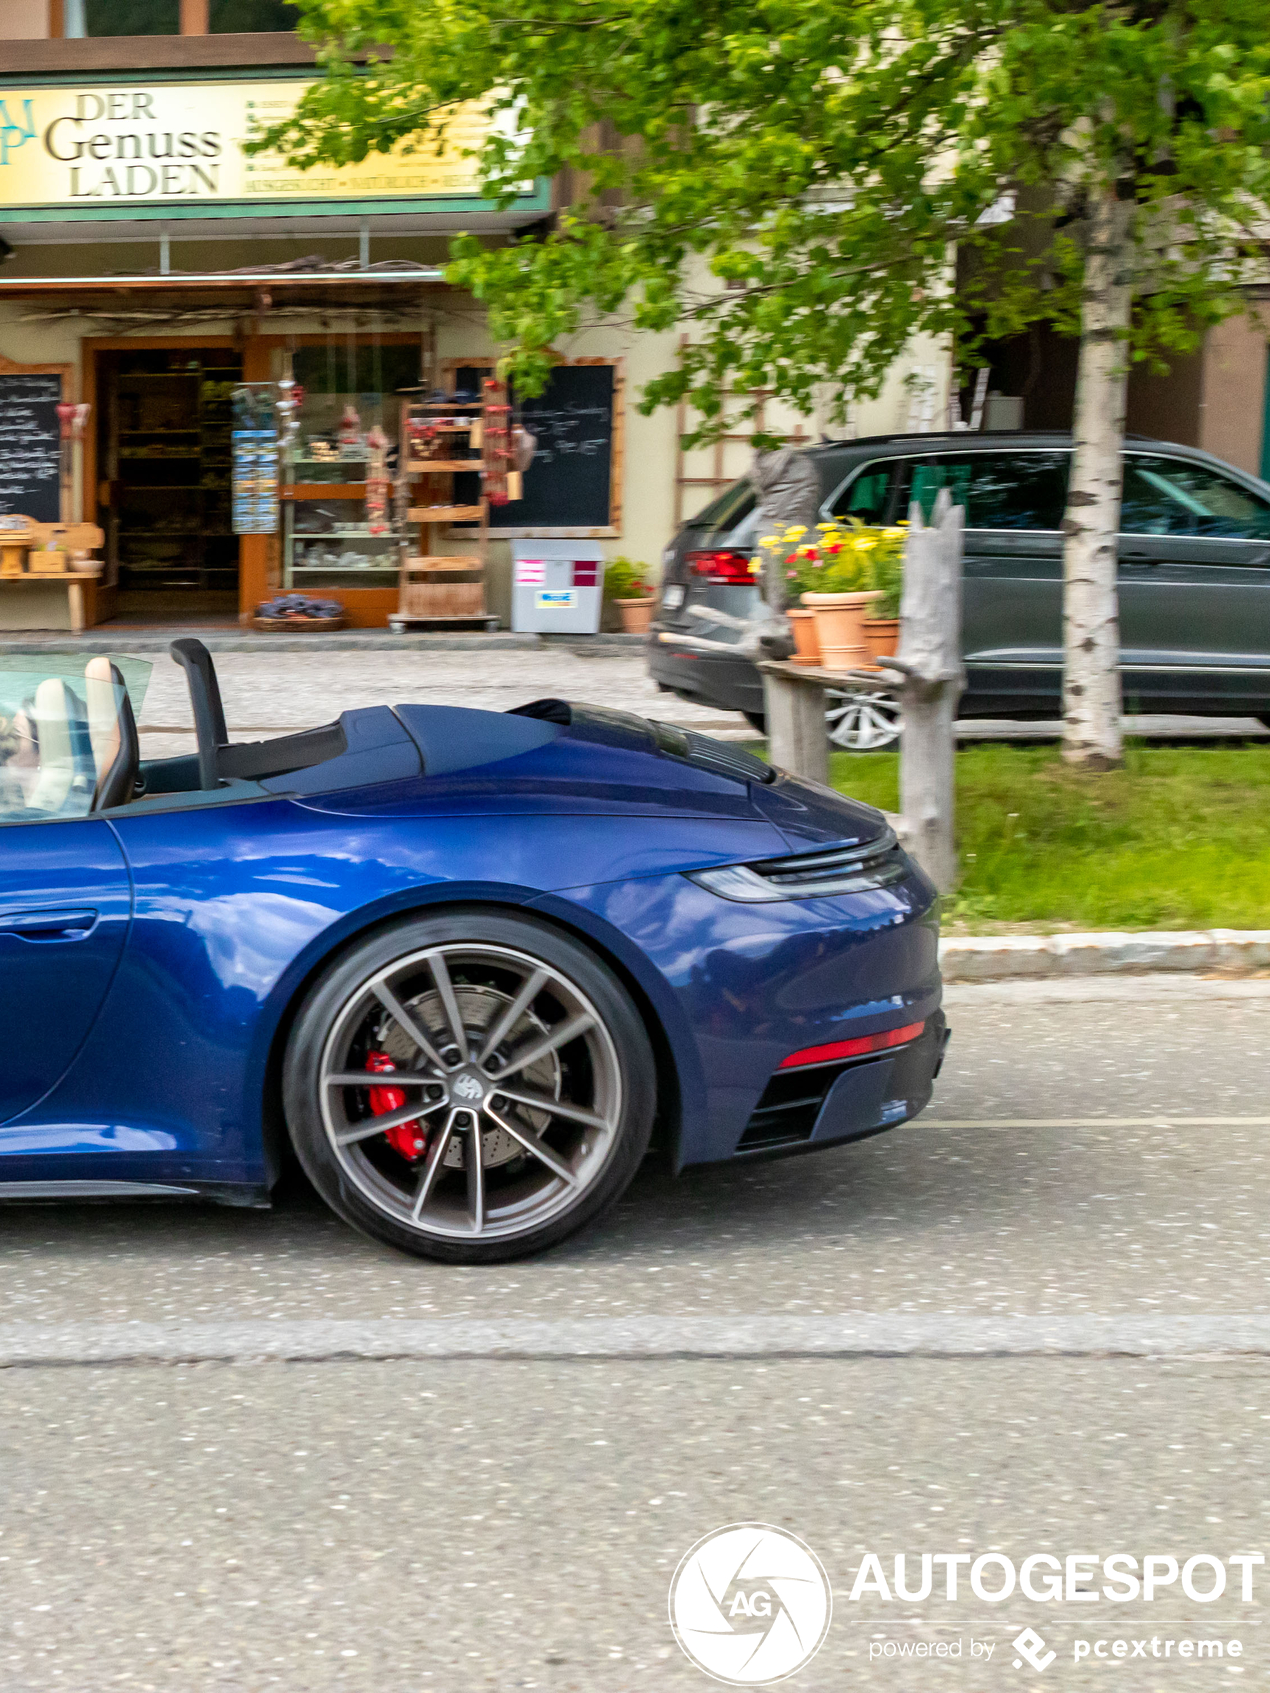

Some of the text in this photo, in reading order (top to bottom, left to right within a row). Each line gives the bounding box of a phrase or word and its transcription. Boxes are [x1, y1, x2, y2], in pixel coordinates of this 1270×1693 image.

[76, 93, 156, 121] DER
[44, 117, 222, 161] Genuss
[68, 164, 220, 197] LADEN
